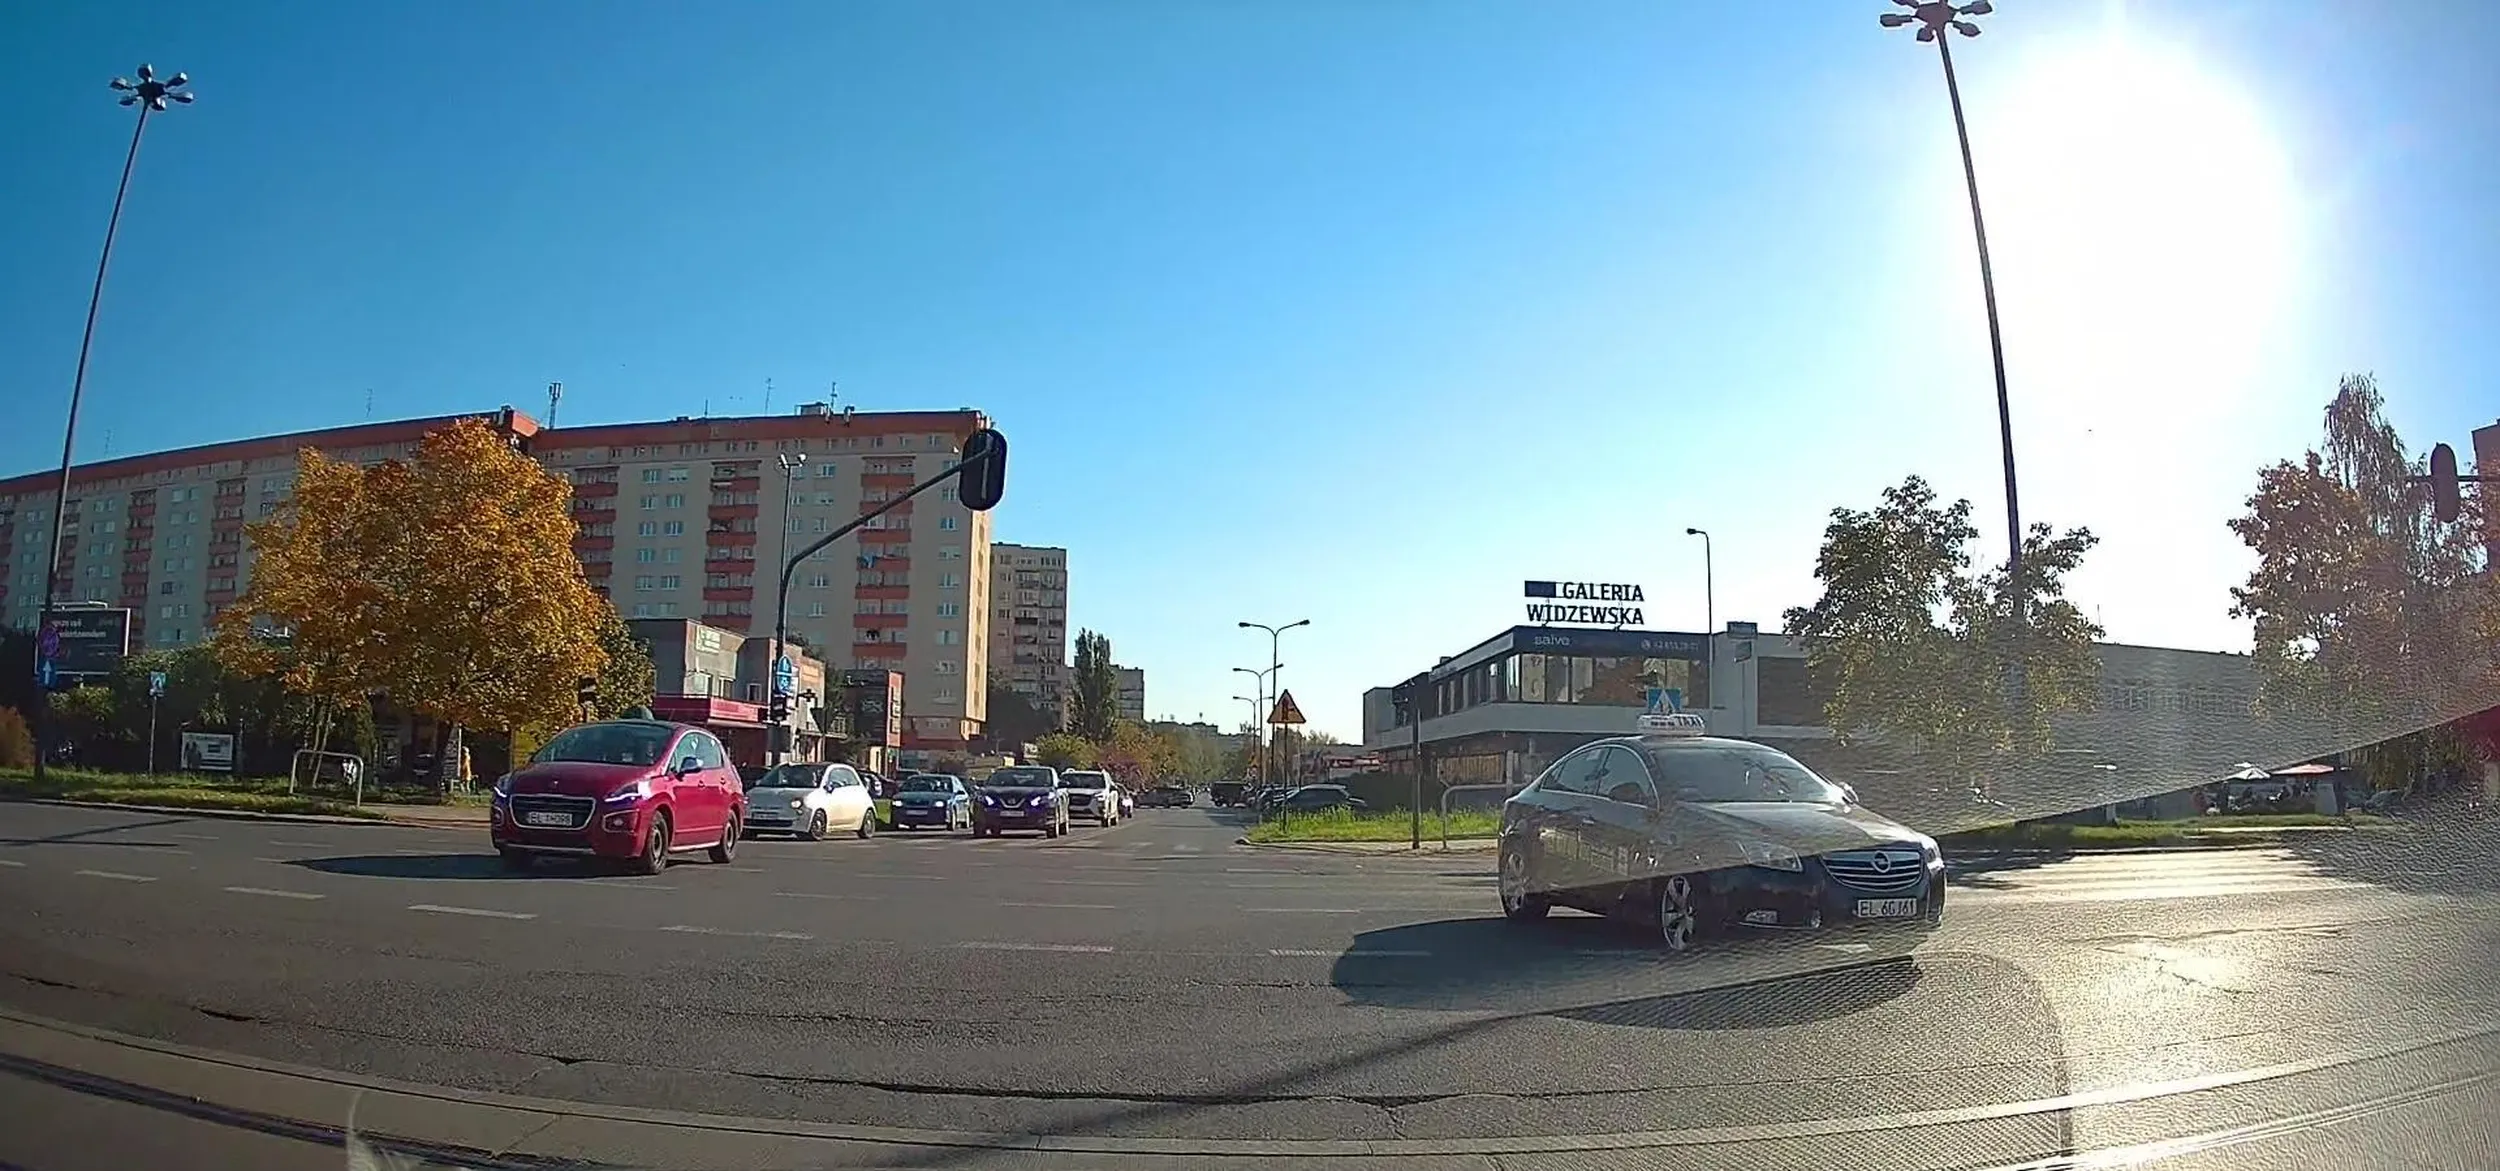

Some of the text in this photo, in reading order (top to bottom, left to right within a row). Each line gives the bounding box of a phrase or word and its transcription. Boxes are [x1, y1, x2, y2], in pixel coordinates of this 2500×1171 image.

[1562, 582, 1645, 602] GALERIA
[1526, 604, 1645, 625] WIDZEWSKA
[1860, 901, 1877, 916] EL
